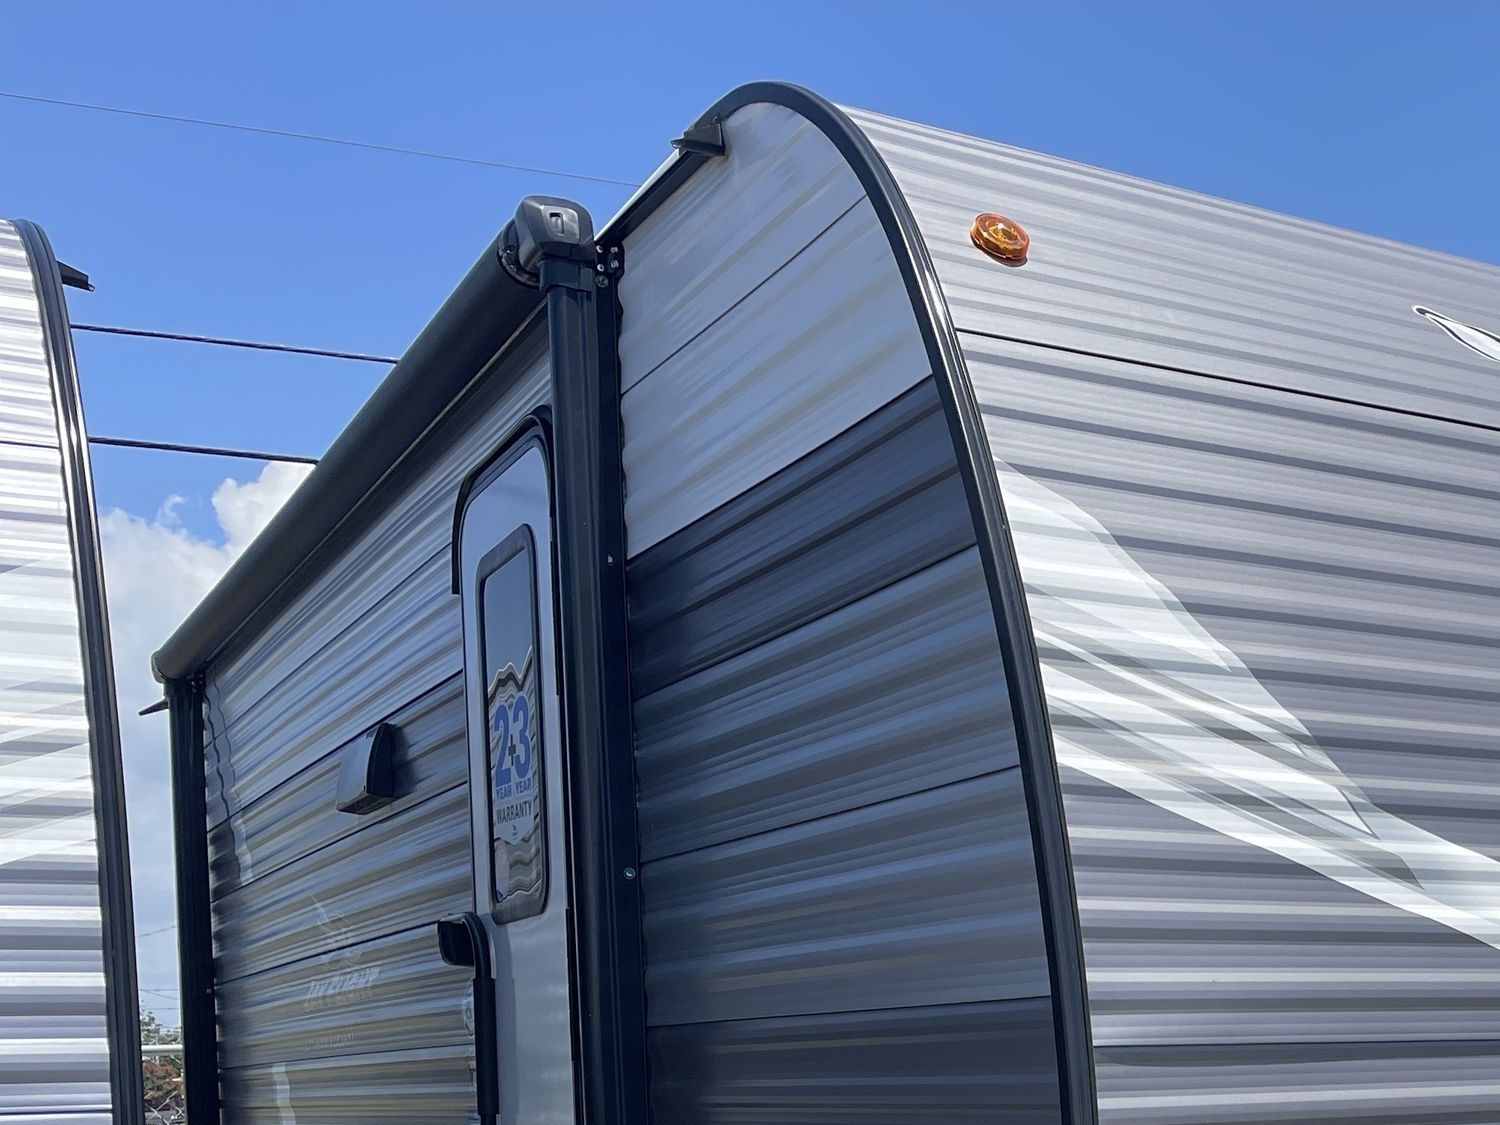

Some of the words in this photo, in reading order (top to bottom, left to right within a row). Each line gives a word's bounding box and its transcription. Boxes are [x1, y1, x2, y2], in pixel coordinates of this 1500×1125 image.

[496, 786, 512, 801] YEAR
[515, 777, 532, 795] YEAR
[496, 800, 533, 825] WARRANTY
